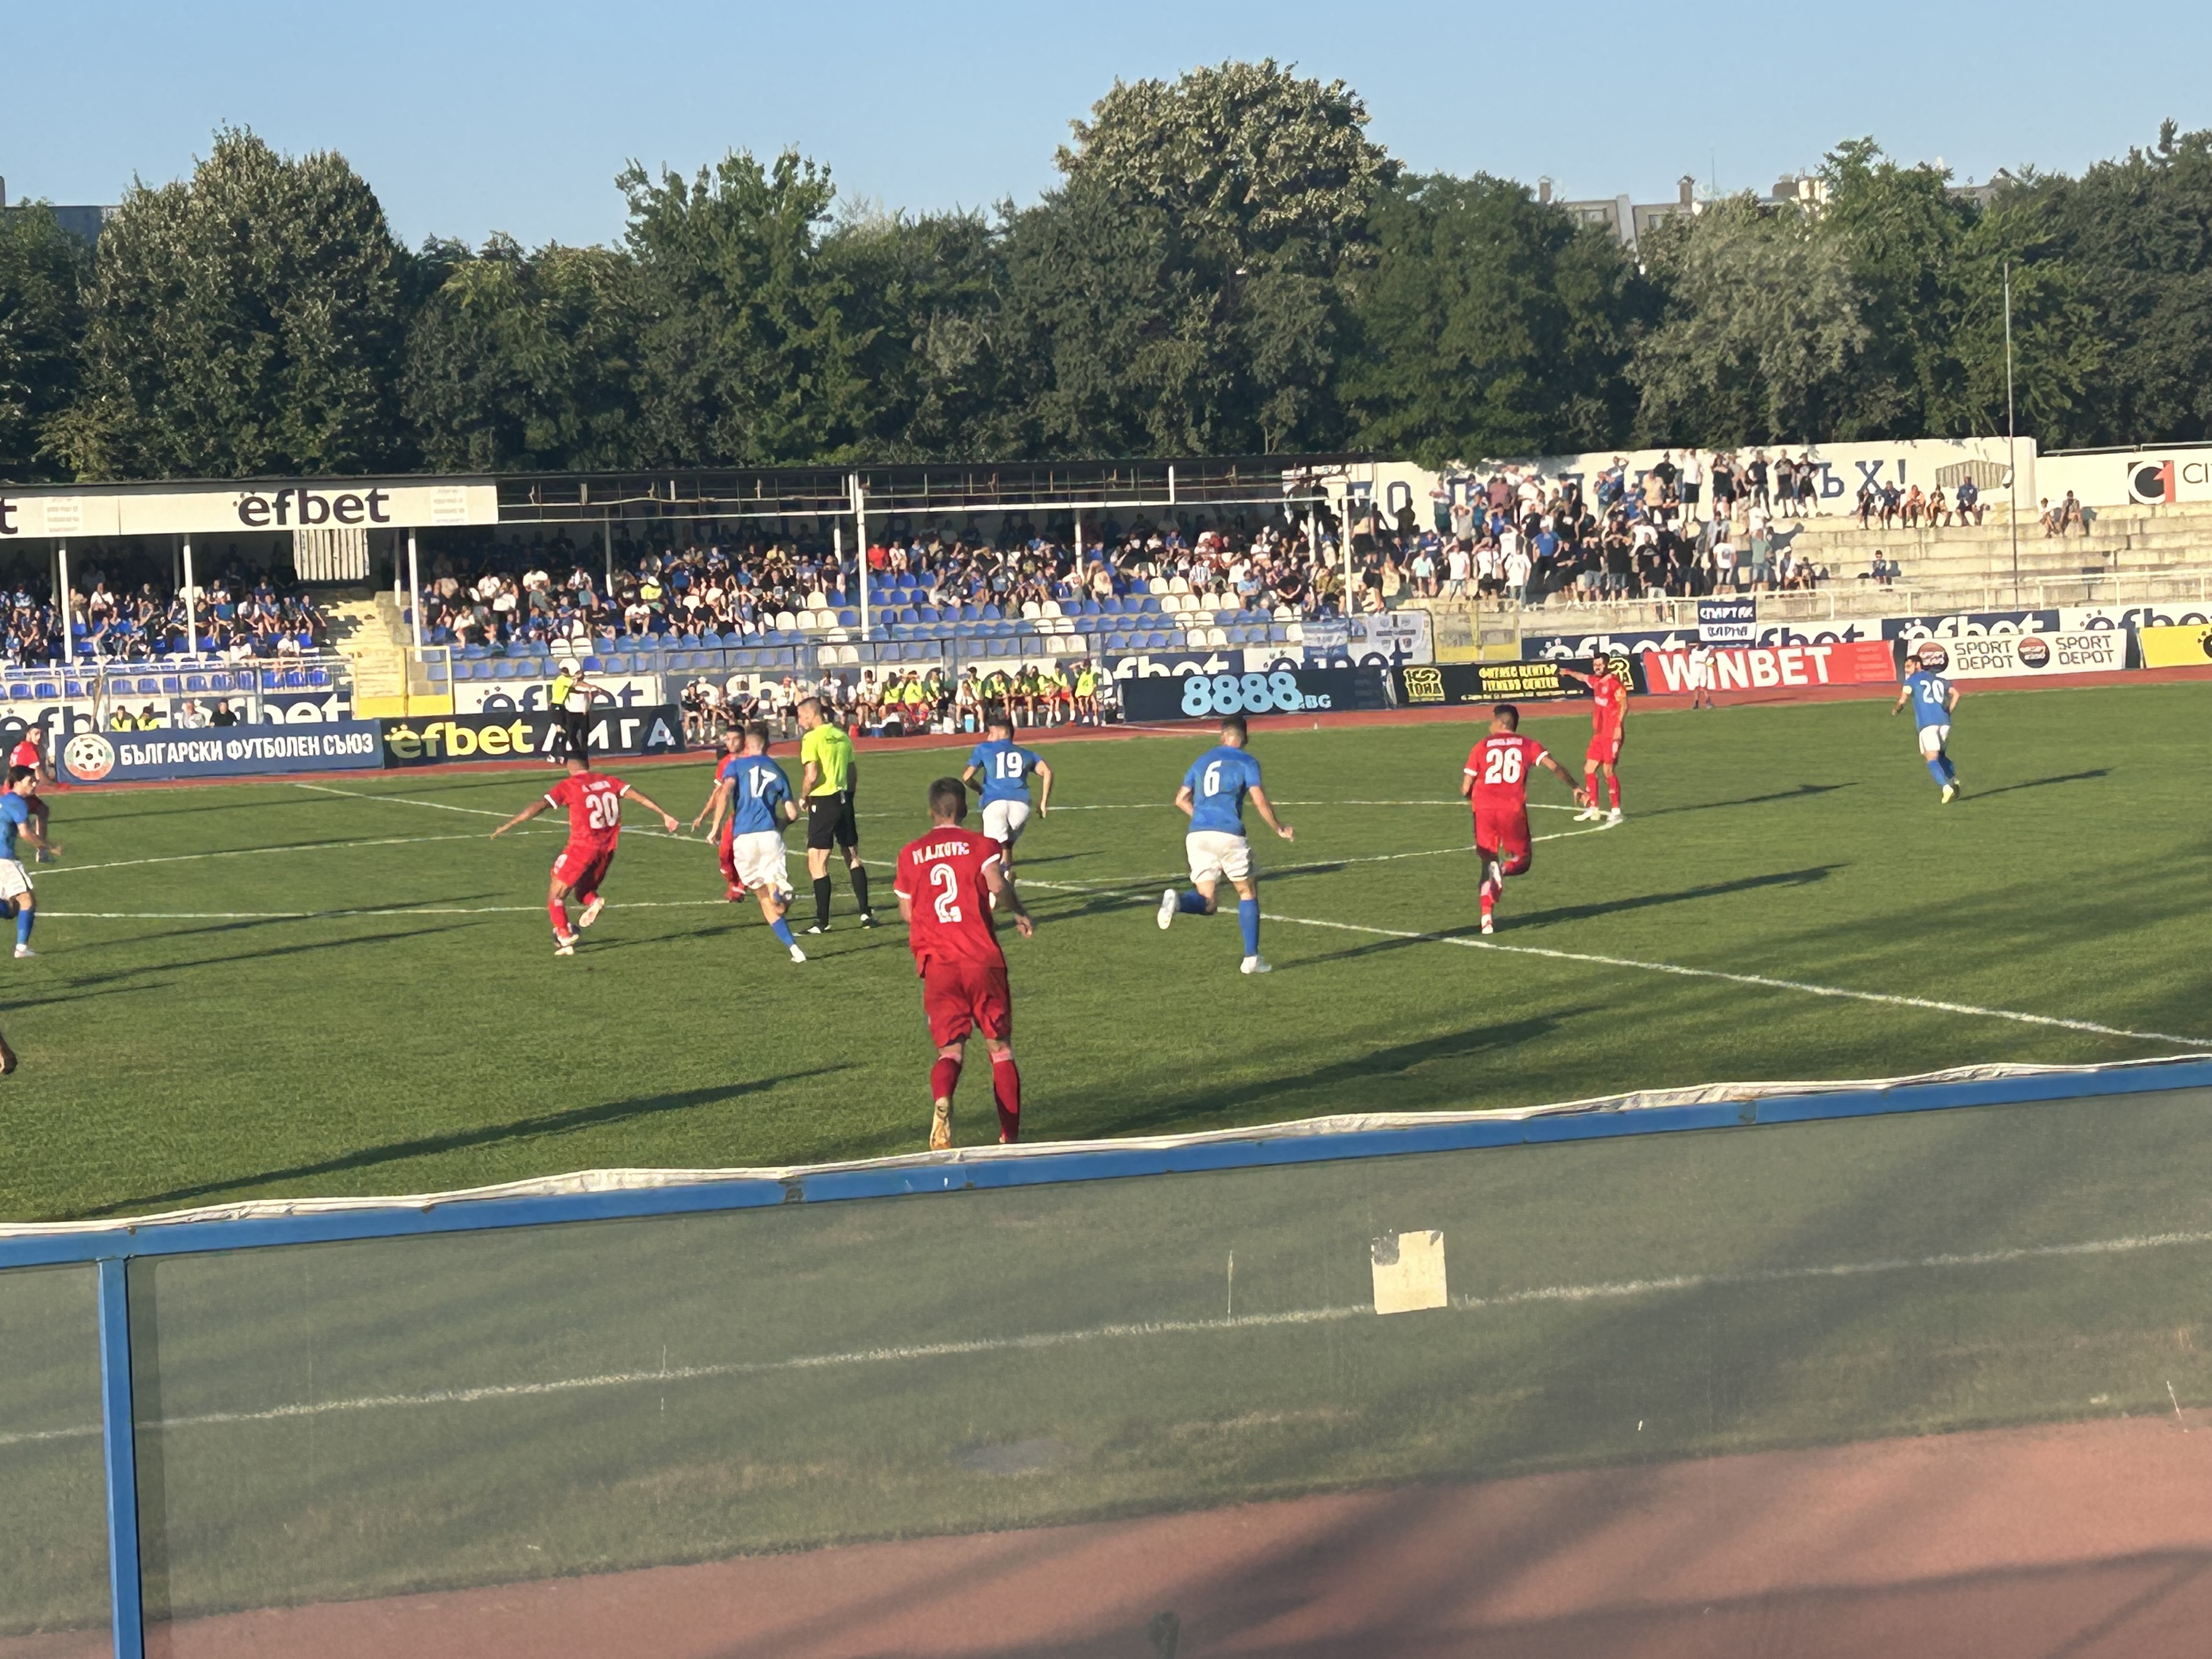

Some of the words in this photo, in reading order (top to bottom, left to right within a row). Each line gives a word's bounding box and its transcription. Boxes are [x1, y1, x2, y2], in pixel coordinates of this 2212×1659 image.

[233, 488, 391, 527] efbet
[1954, 640, 2012, 655] SPORT
[2056, 635, 2112, 650] SPORT
[2057, 650, 2114, 664] DEPOT
[1957, 655, 2013, 670] DEPOT
[1920, 680, 1944, 704] 20
[120, 741, 223, 765] БЪЛГАРСКИ
[226, 736, 320, 760] ФУТБОЛЕН
[323, 733, 374, 755] СЪЮЗ
[384, 719, 534, 758] efbet
[996, 751, 1023, 779] 19
[1203, 760, 1222, 797] 6
[1485, 747, 1522, 785] 26
[749, 765, 777, 798] 17
[585, 792, 619, 830] 20
[930, 863, 962, 924] 2
